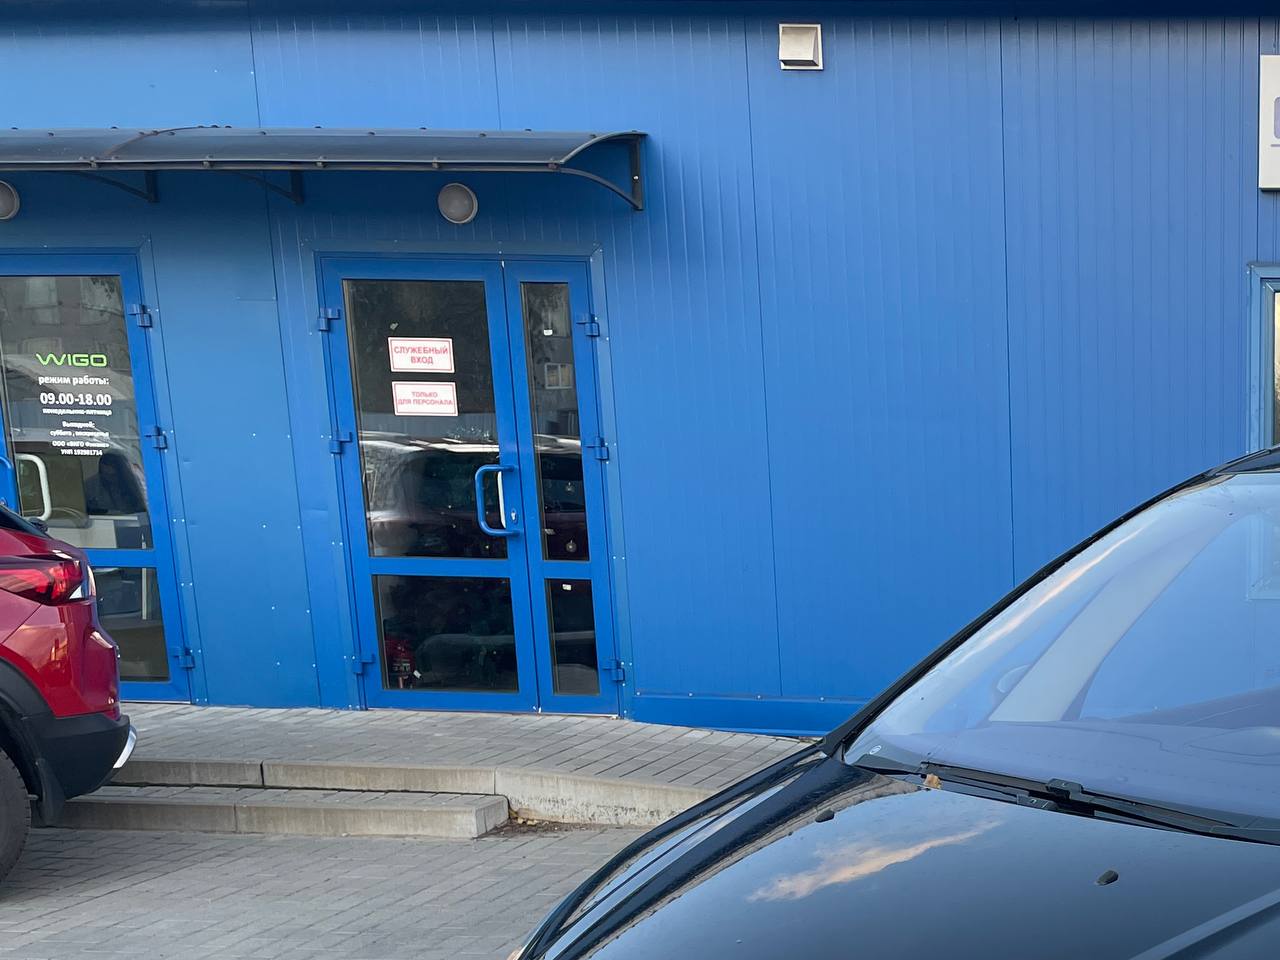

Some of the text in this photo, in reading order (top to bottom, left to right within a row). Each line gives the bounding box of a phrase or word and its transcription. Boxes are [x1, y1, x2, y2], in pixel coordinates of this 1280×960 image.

[394, 345, 448, 355] СЛУЖЕБНЫЙ
[36, 353, 107, 367] WIGO
[411, 356, 434, 365] ВХОД
[39, 375, 110, 386] режим работы:
[40, 393, 112, 406] 09.00-18.00
